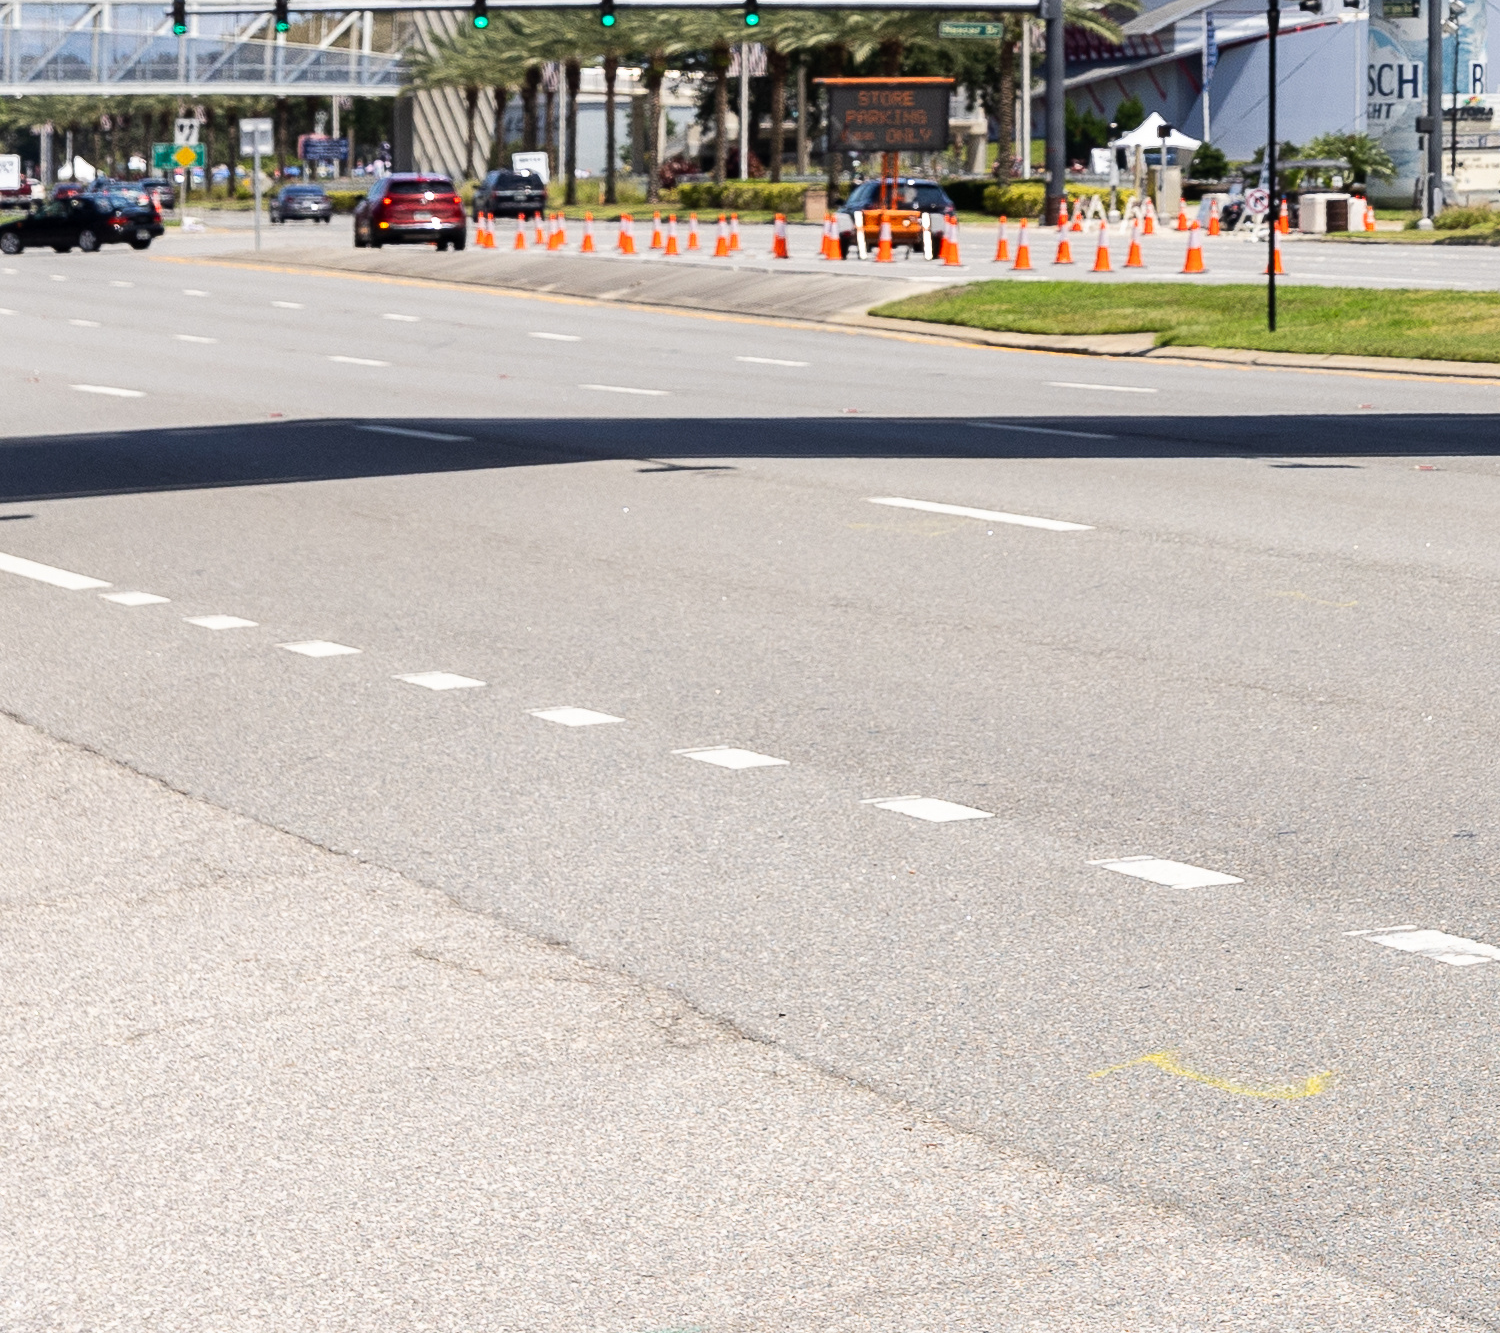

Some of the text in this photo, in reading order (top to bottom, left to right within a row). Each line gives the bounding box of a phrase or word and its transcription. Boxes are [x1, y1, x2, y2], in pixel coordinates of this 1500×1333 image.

[858, 90, 916, 107] STORE
[846, 110, 927, 124] PARKING
[885, 128, 932, 144] ONLY
